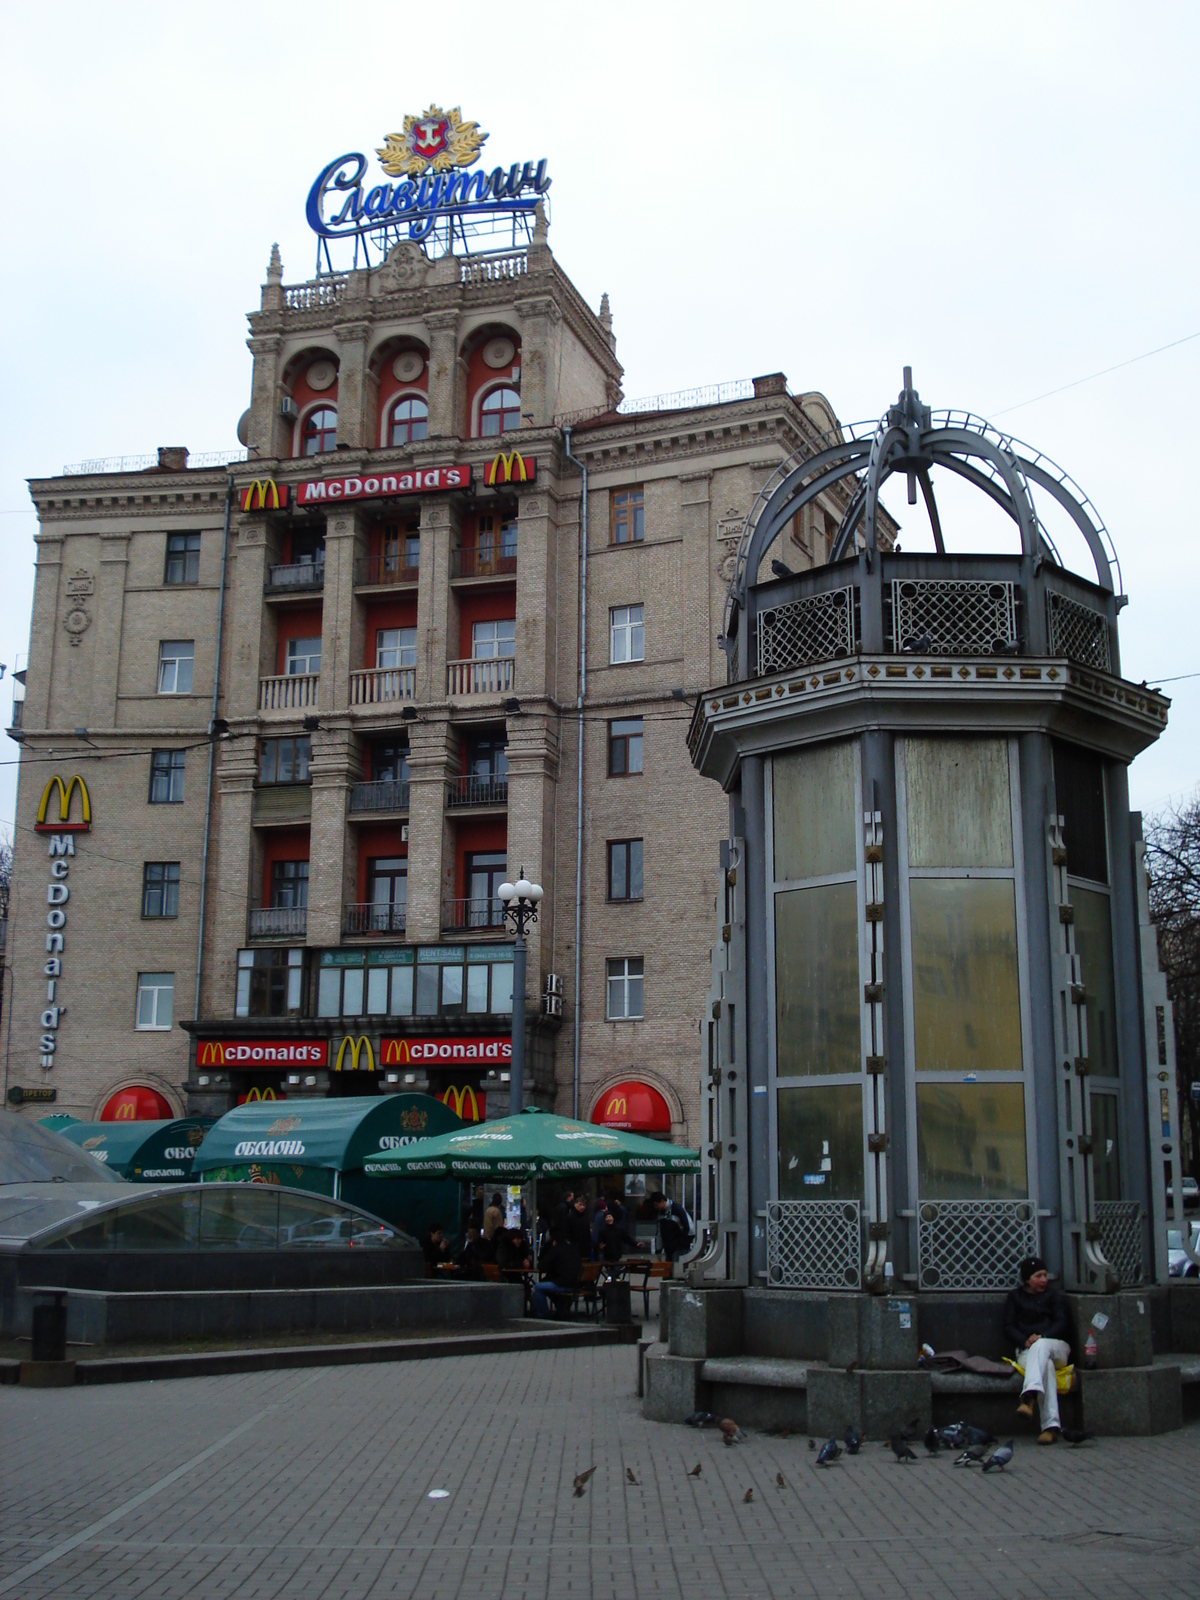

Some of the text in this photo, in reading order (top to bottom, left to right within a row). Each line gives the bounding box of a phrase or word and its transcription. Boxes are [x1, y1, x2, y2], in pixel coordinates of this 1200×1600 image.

[305, 152, 552, 241] Славутич
[304, 468, 461, 501] McDonald's
[202, 1042, 322, 1065] McDonald's
[386, 1039, 512, 1063] McDonald's
[234, 1140, 306, 1156] ОБОЛОНЬ
